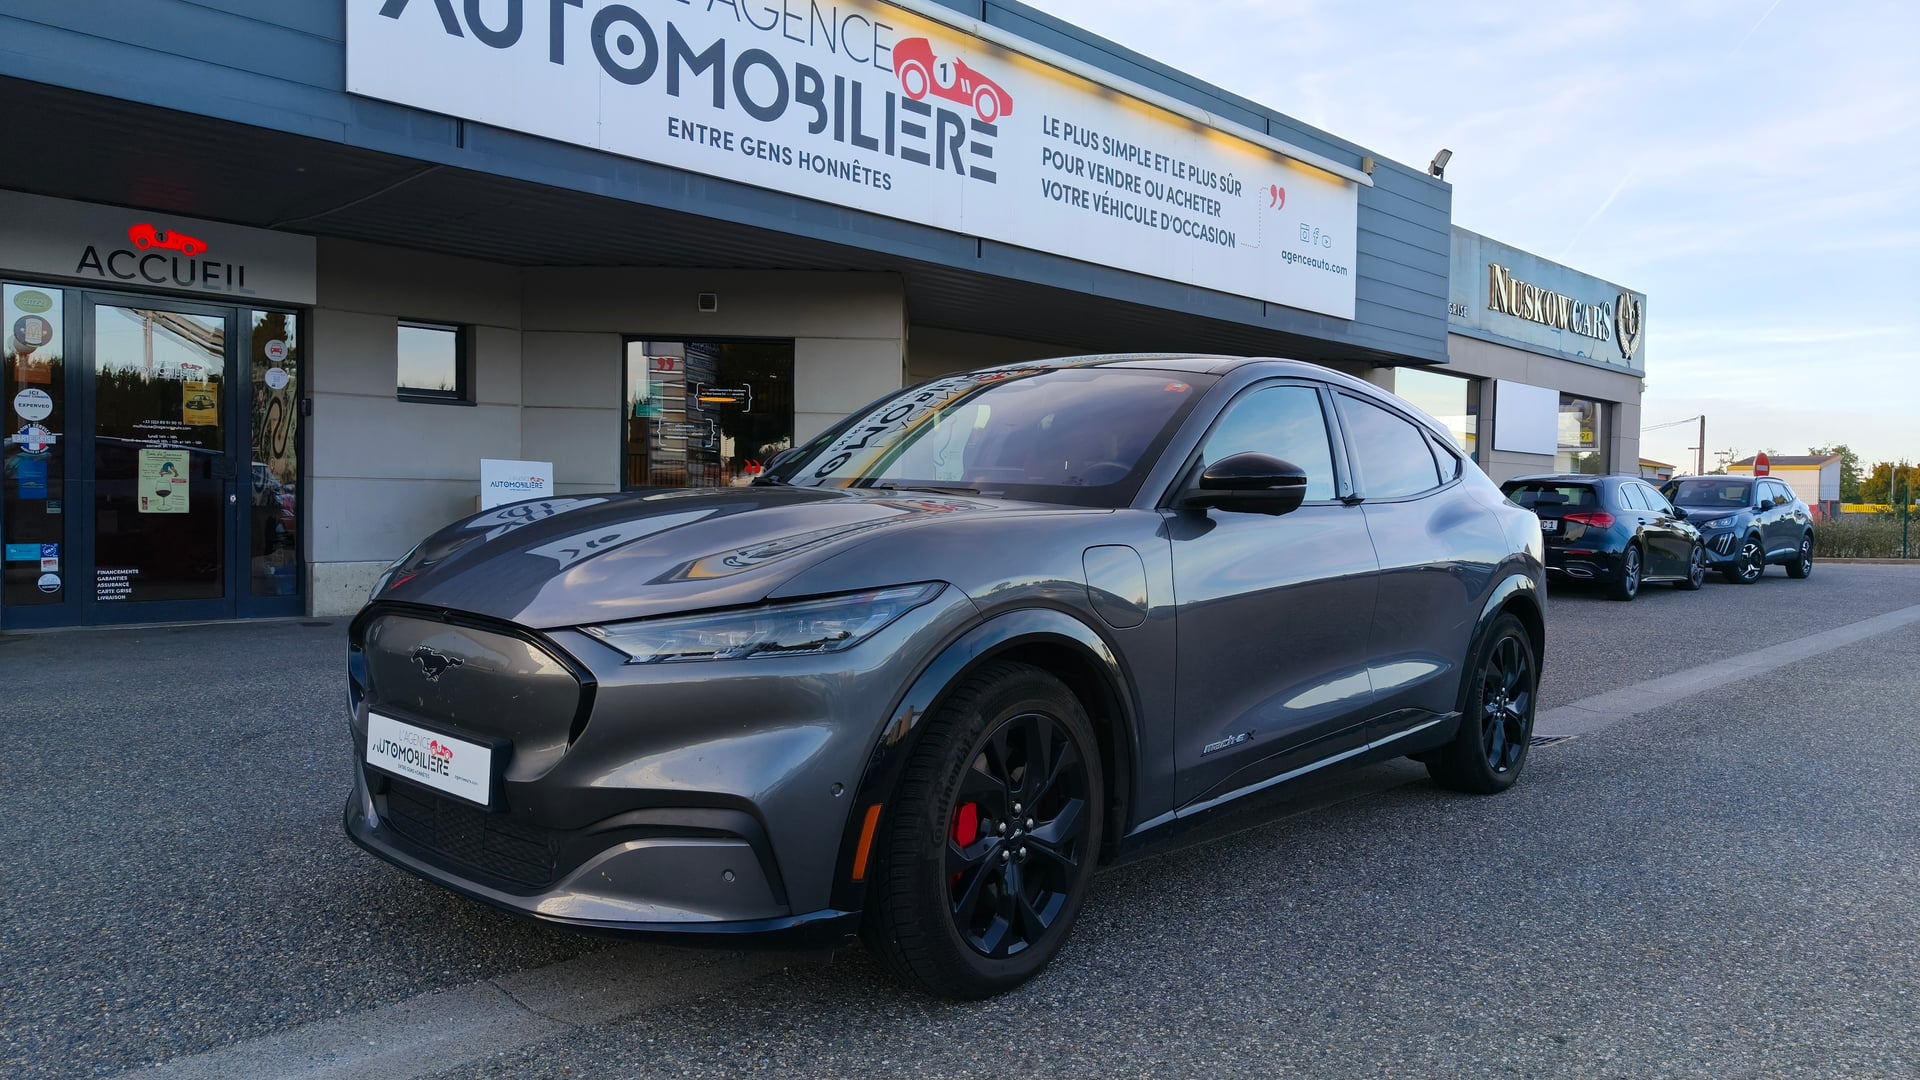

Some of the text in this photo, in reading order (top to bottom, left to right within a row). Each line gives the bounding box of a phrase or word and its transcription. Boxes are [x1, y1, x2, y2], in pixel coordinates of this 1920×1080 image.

[668, 116, 892, 191] ENTRE GENS HONNÊTES
[1042, 147, 1221, 218] POUR VENDRE OU ACHETER
[1043, 115, 1242, 198] LE PLUS SIMPLE ET LE PLUS SÛR
[1041, 178, 1236, 249] VOTRE VÉHICULE D'OCCASION
[75, 245, 256, 295] ACCUEIL
[1281, 249, 1348, 276] agenceauto.com
[1448, 302, 1468, 318] GRISE
